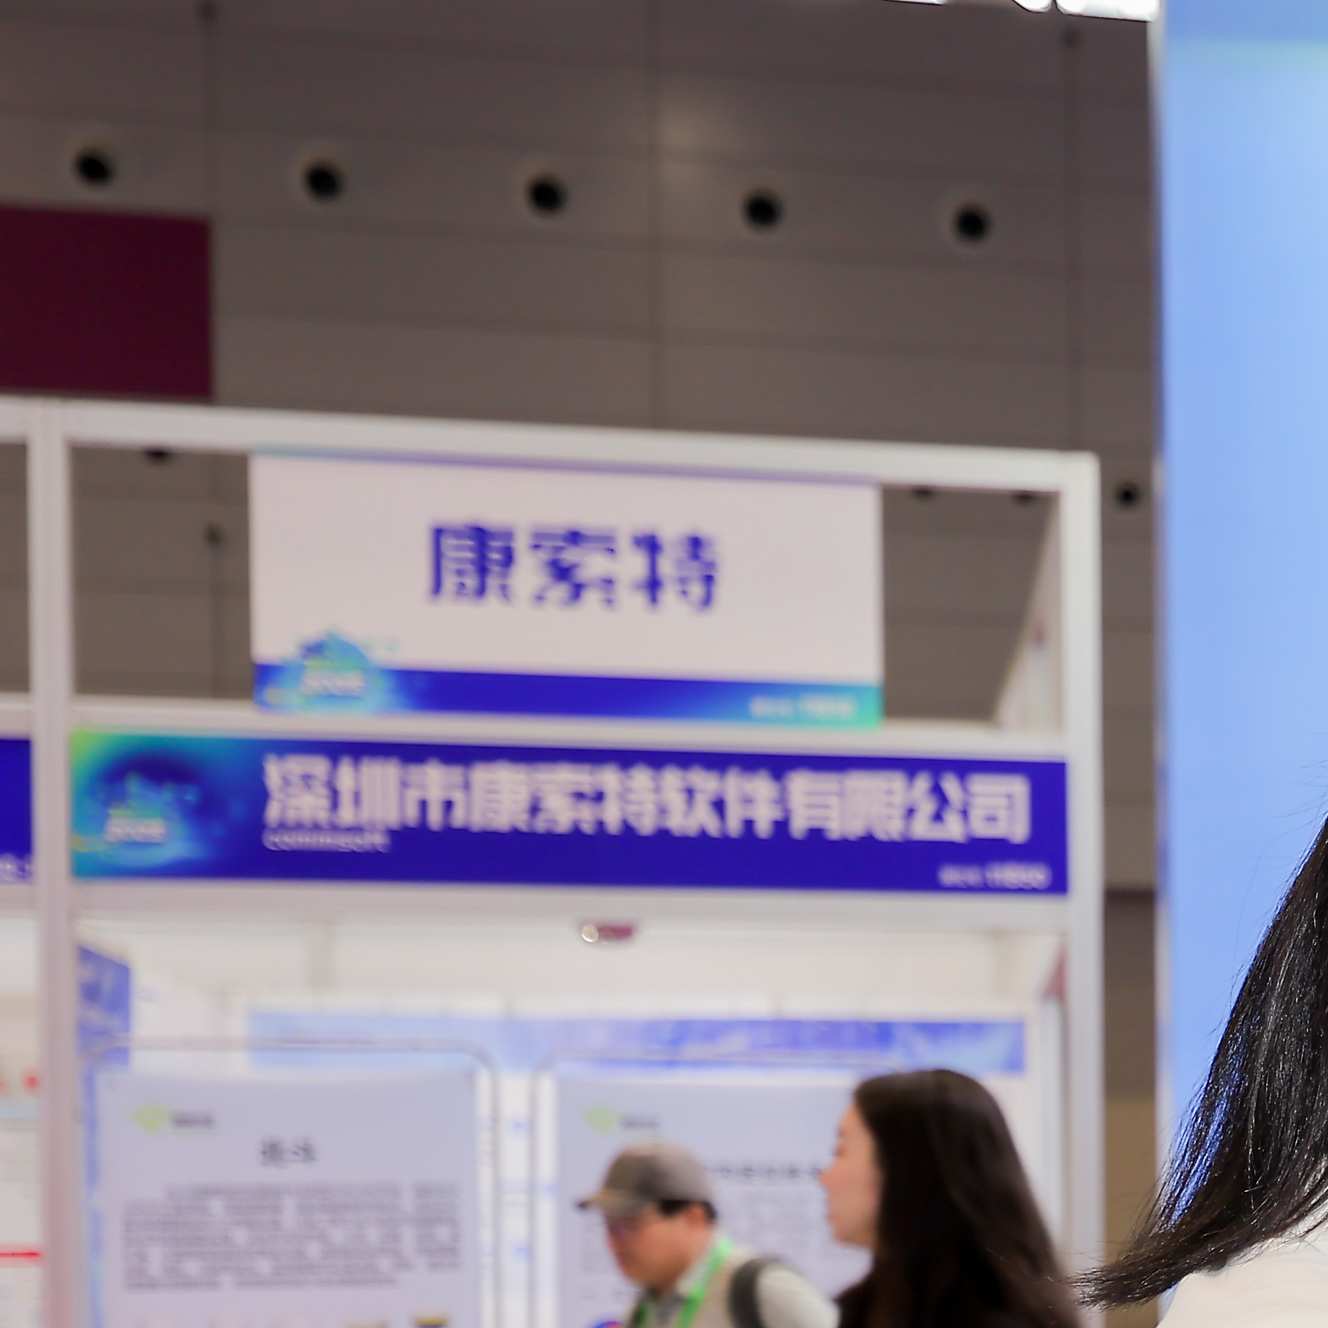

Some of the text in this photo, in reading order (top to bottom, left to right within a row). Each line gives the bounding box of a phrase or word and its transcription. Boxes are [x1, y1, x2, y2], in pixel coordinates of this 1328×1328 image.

[428, 520, 720, 612] 康索特
[263, 752, 1031, 845] 深圳市康索特软件有限公司
